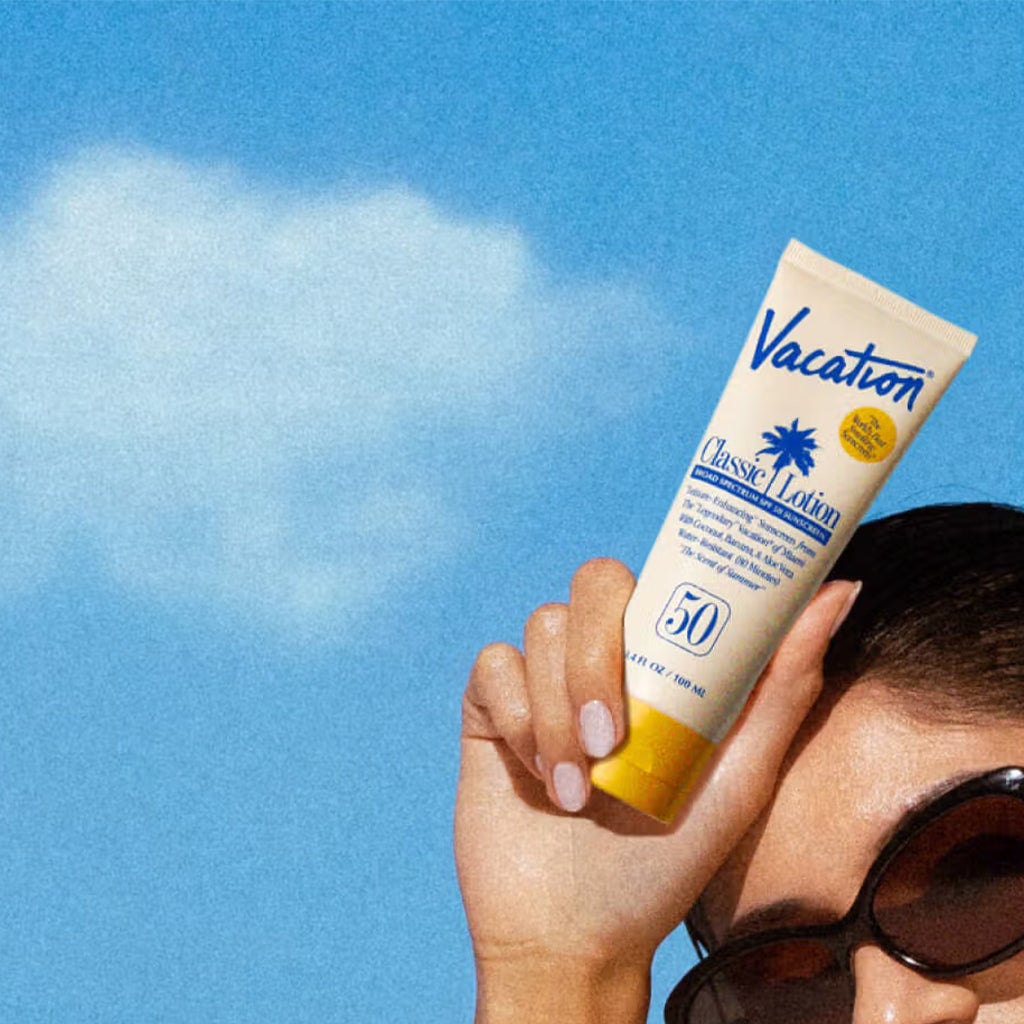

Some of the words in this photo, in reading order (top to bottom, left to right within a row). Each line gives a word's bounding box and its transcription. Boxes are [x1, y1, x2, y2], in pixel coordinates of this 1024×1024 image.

[699, 436, 766, 487] Classic
[777, 471, 842, 530] Lotion
[694, 468, 719, 483] BROAD
[719, 478, 760, 501] SPECTRUM
[759, 497, 773, 511] SPF
[782, 508, 828, 540] SUNSCREEN
[772, 543, 783, 555] of
[782, 547, 807, 568] Miami
[795, 540, 817, 559] from
[665, 591, 718, 646] 50
[649, 663, 666, 675] OZ
[674, 674, 692, 689] 100
